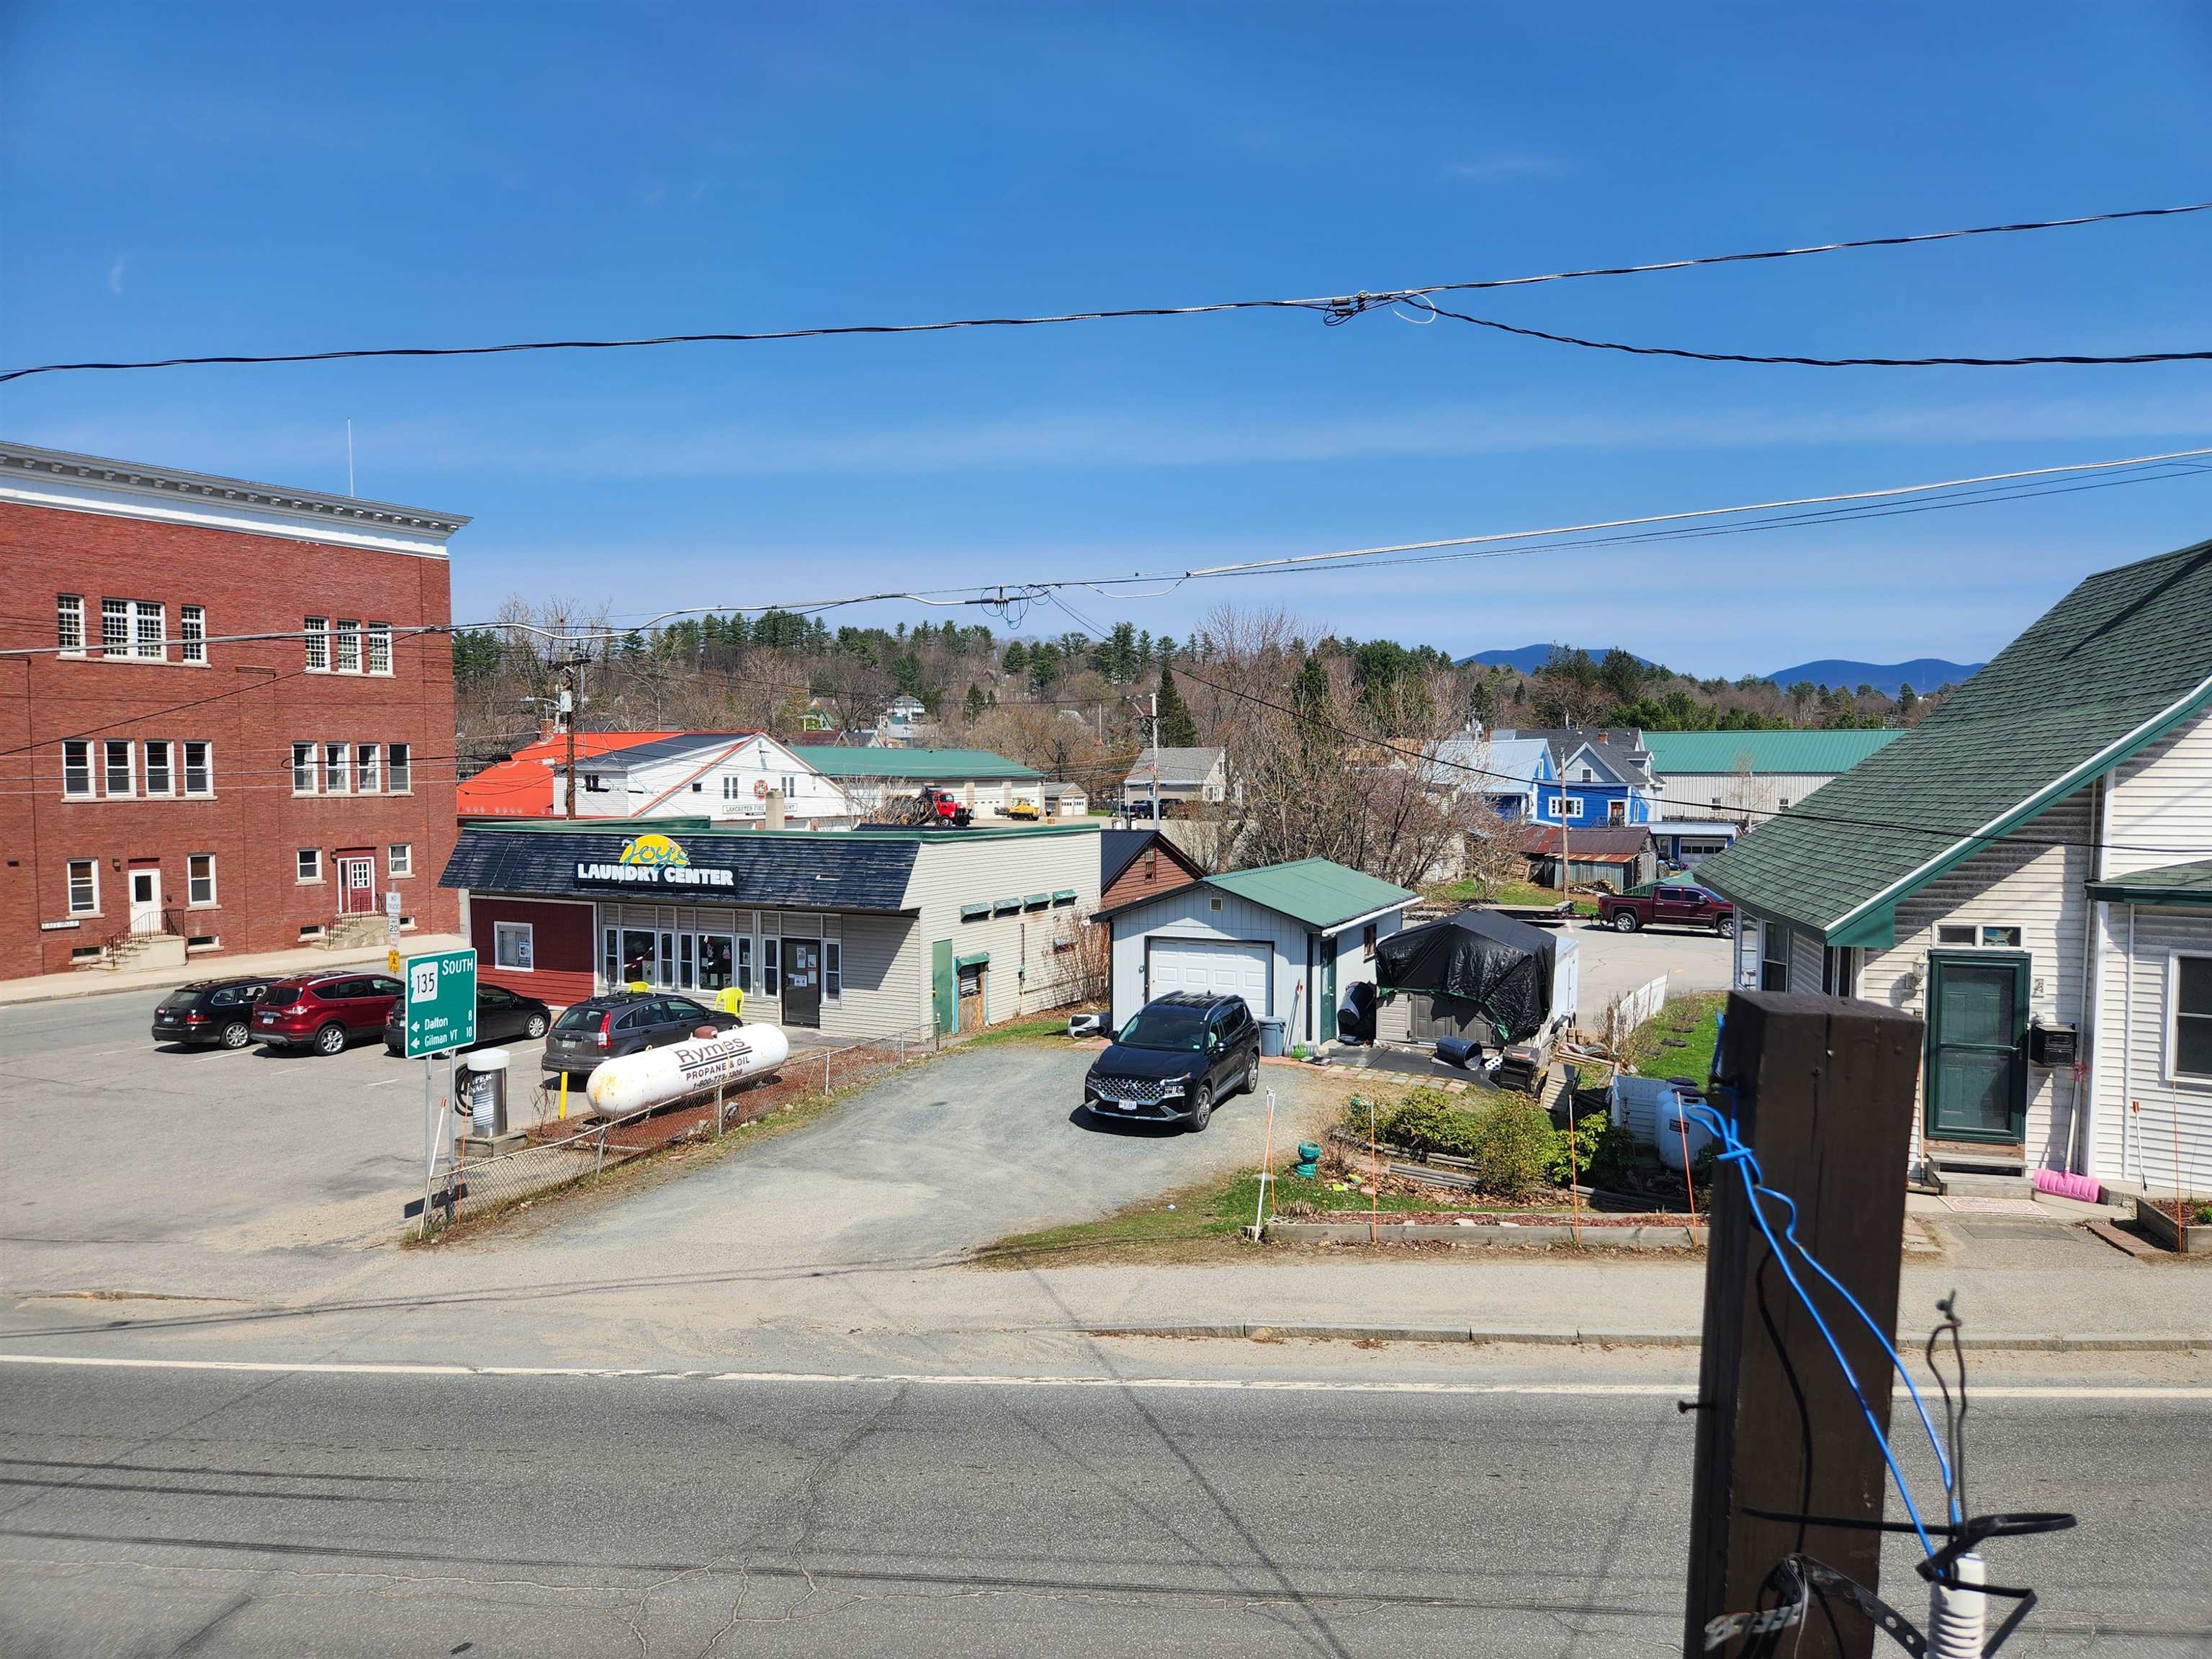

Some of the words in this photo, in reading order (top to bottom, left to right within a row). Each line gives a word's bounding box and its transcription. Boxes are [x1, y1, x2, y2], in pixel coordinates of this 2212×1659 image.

[577, 863, 659, 882] LAUNDRY
[663, 867, 734, 886] CENTER
[441, 958, 474, 976] SOUTH
[416, 972, 435, 994] 135
[424, 1017, 449, 1031] Dalton
[468, 1010, 473, 1021] 8
[424, 1034, 448, 1048] Gilman
[449, 1028, 459, 1041] VT
[466, 1026, 472, 1038] 10
[674, 1038, 745, 1063] Rymes
[686, 1063, 727, 1081] PROPANE
[737, 1056, 751, 1066] OIL
